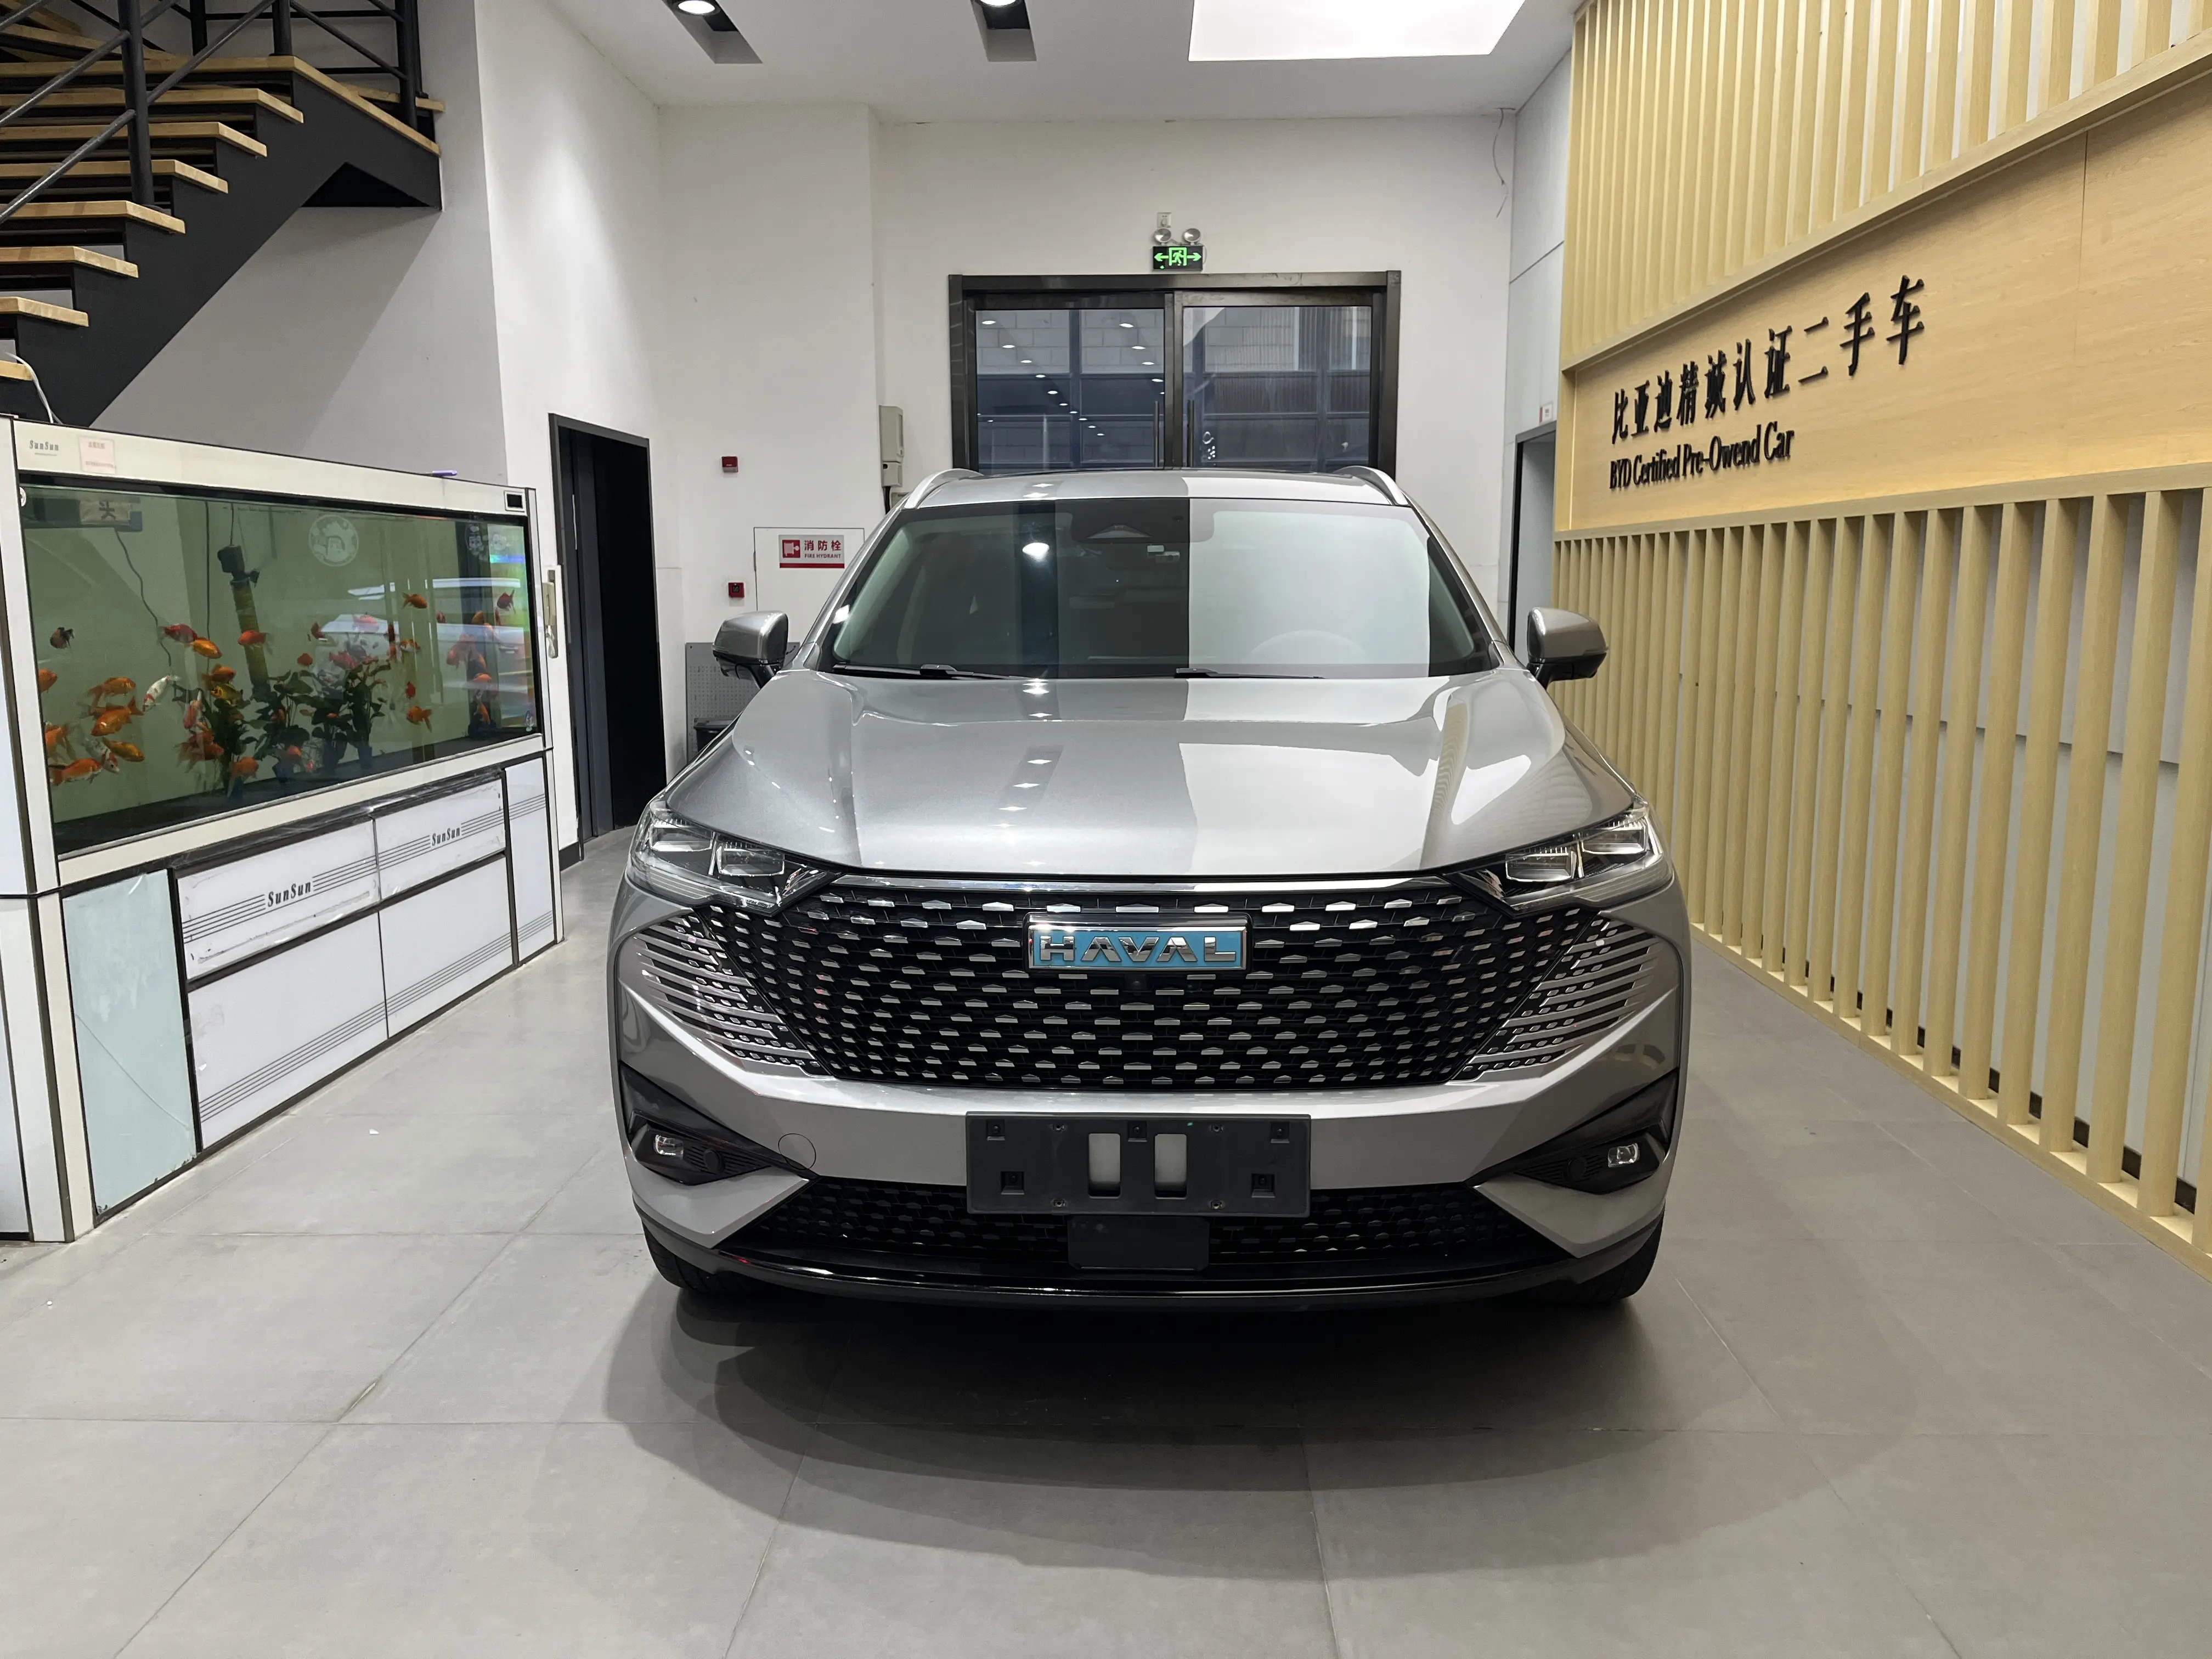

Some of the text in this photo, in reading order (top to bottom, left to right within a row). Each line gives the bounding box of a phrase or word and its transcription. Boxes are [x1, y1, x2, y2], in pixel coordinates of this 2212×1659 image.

[1611, 274, 1925, 445] 比亚迪精诚认证二手车
[29, 439, 59, 451] SunSun
[1610, 421, 1795, 489] BYD Certified Pre-Owend Car
[804, 539, 842, 551] 消防栓
[431, 827, 460, 847] SunSun
[268, 881, 311, 907] SunSun
[1040, 935, 1235, 962] HAVAL
